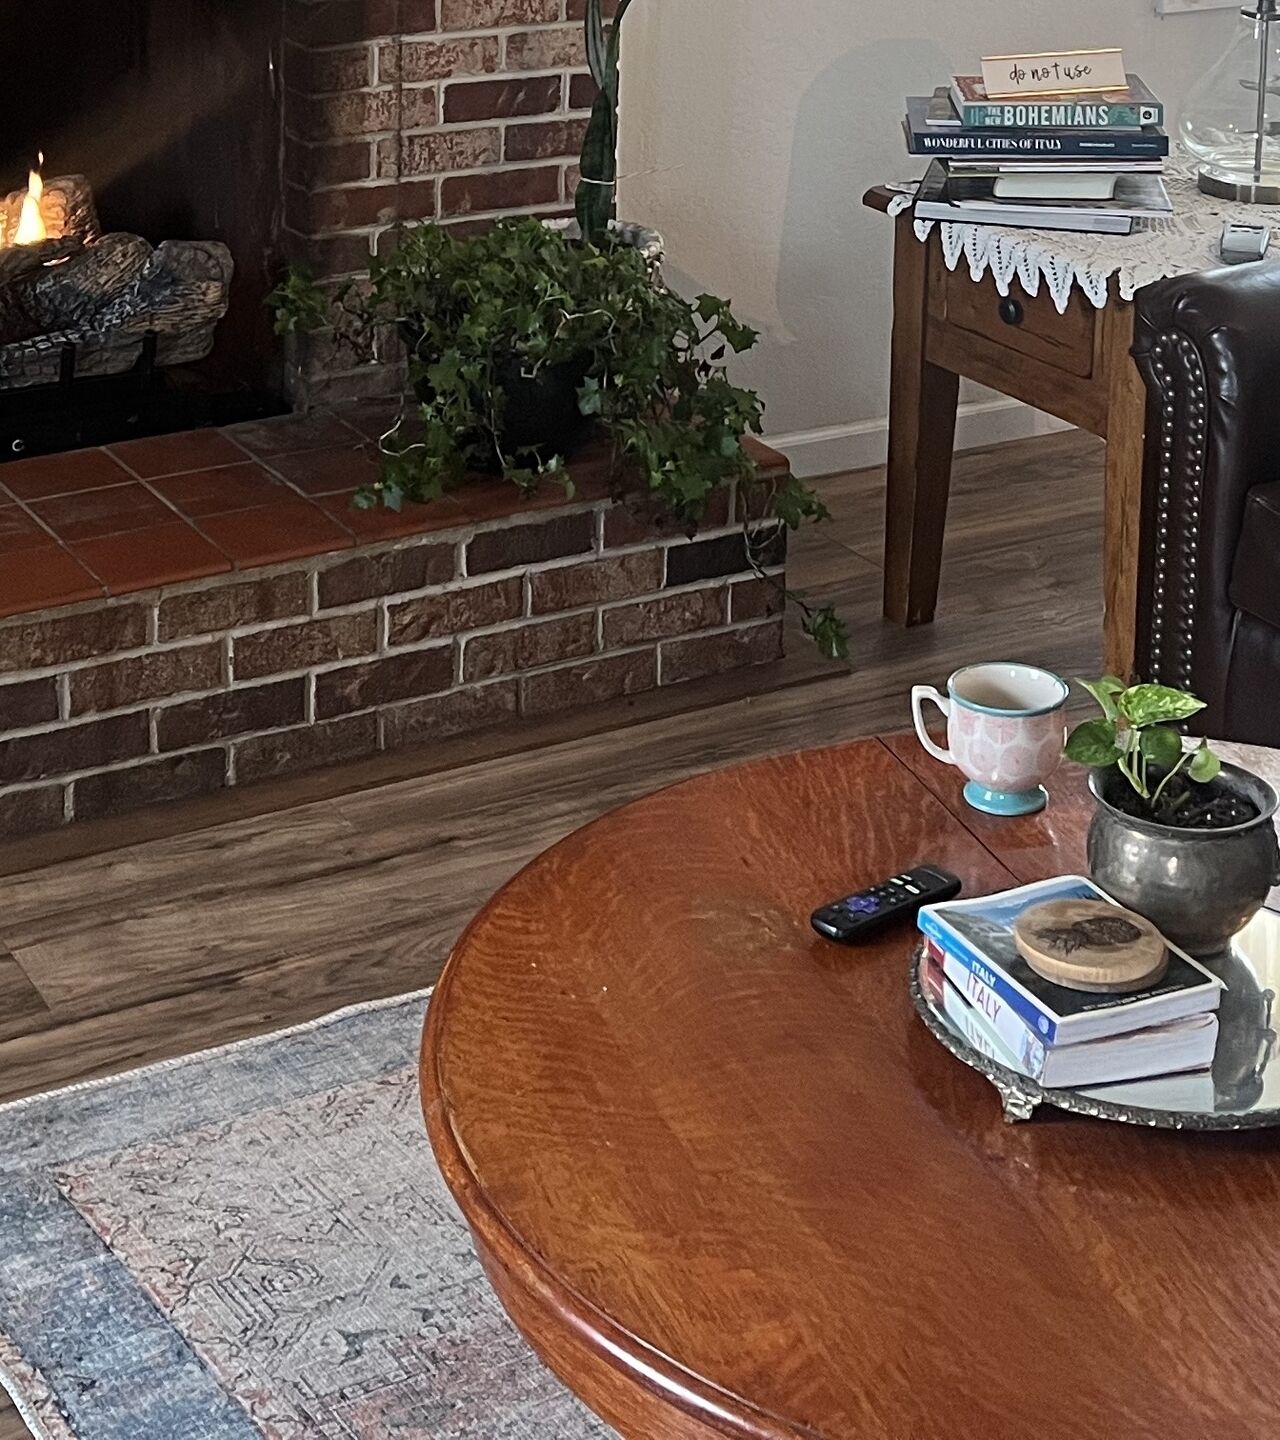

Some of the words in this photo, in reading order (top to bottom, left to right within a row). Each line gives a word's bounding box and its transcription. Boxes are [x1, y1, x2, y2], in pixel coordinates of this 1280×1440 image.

[1009, 63, 1026, 85] do
[1031, 62, 1060, 81] not
[1063, 64, 1092, 80] use
[1004, 105, 1109, 126] BOHEMIANS
[923, 137, 984, 149] WONDERFUL
[985, 138, 1018, 149] CITIES
[1019, 138, 1033, 149] OF
[1034, 139, 1062, 150] ITALY
[972, 960, 996, 988] ITALY
[966, 971, 1001, 1024] ITALY
